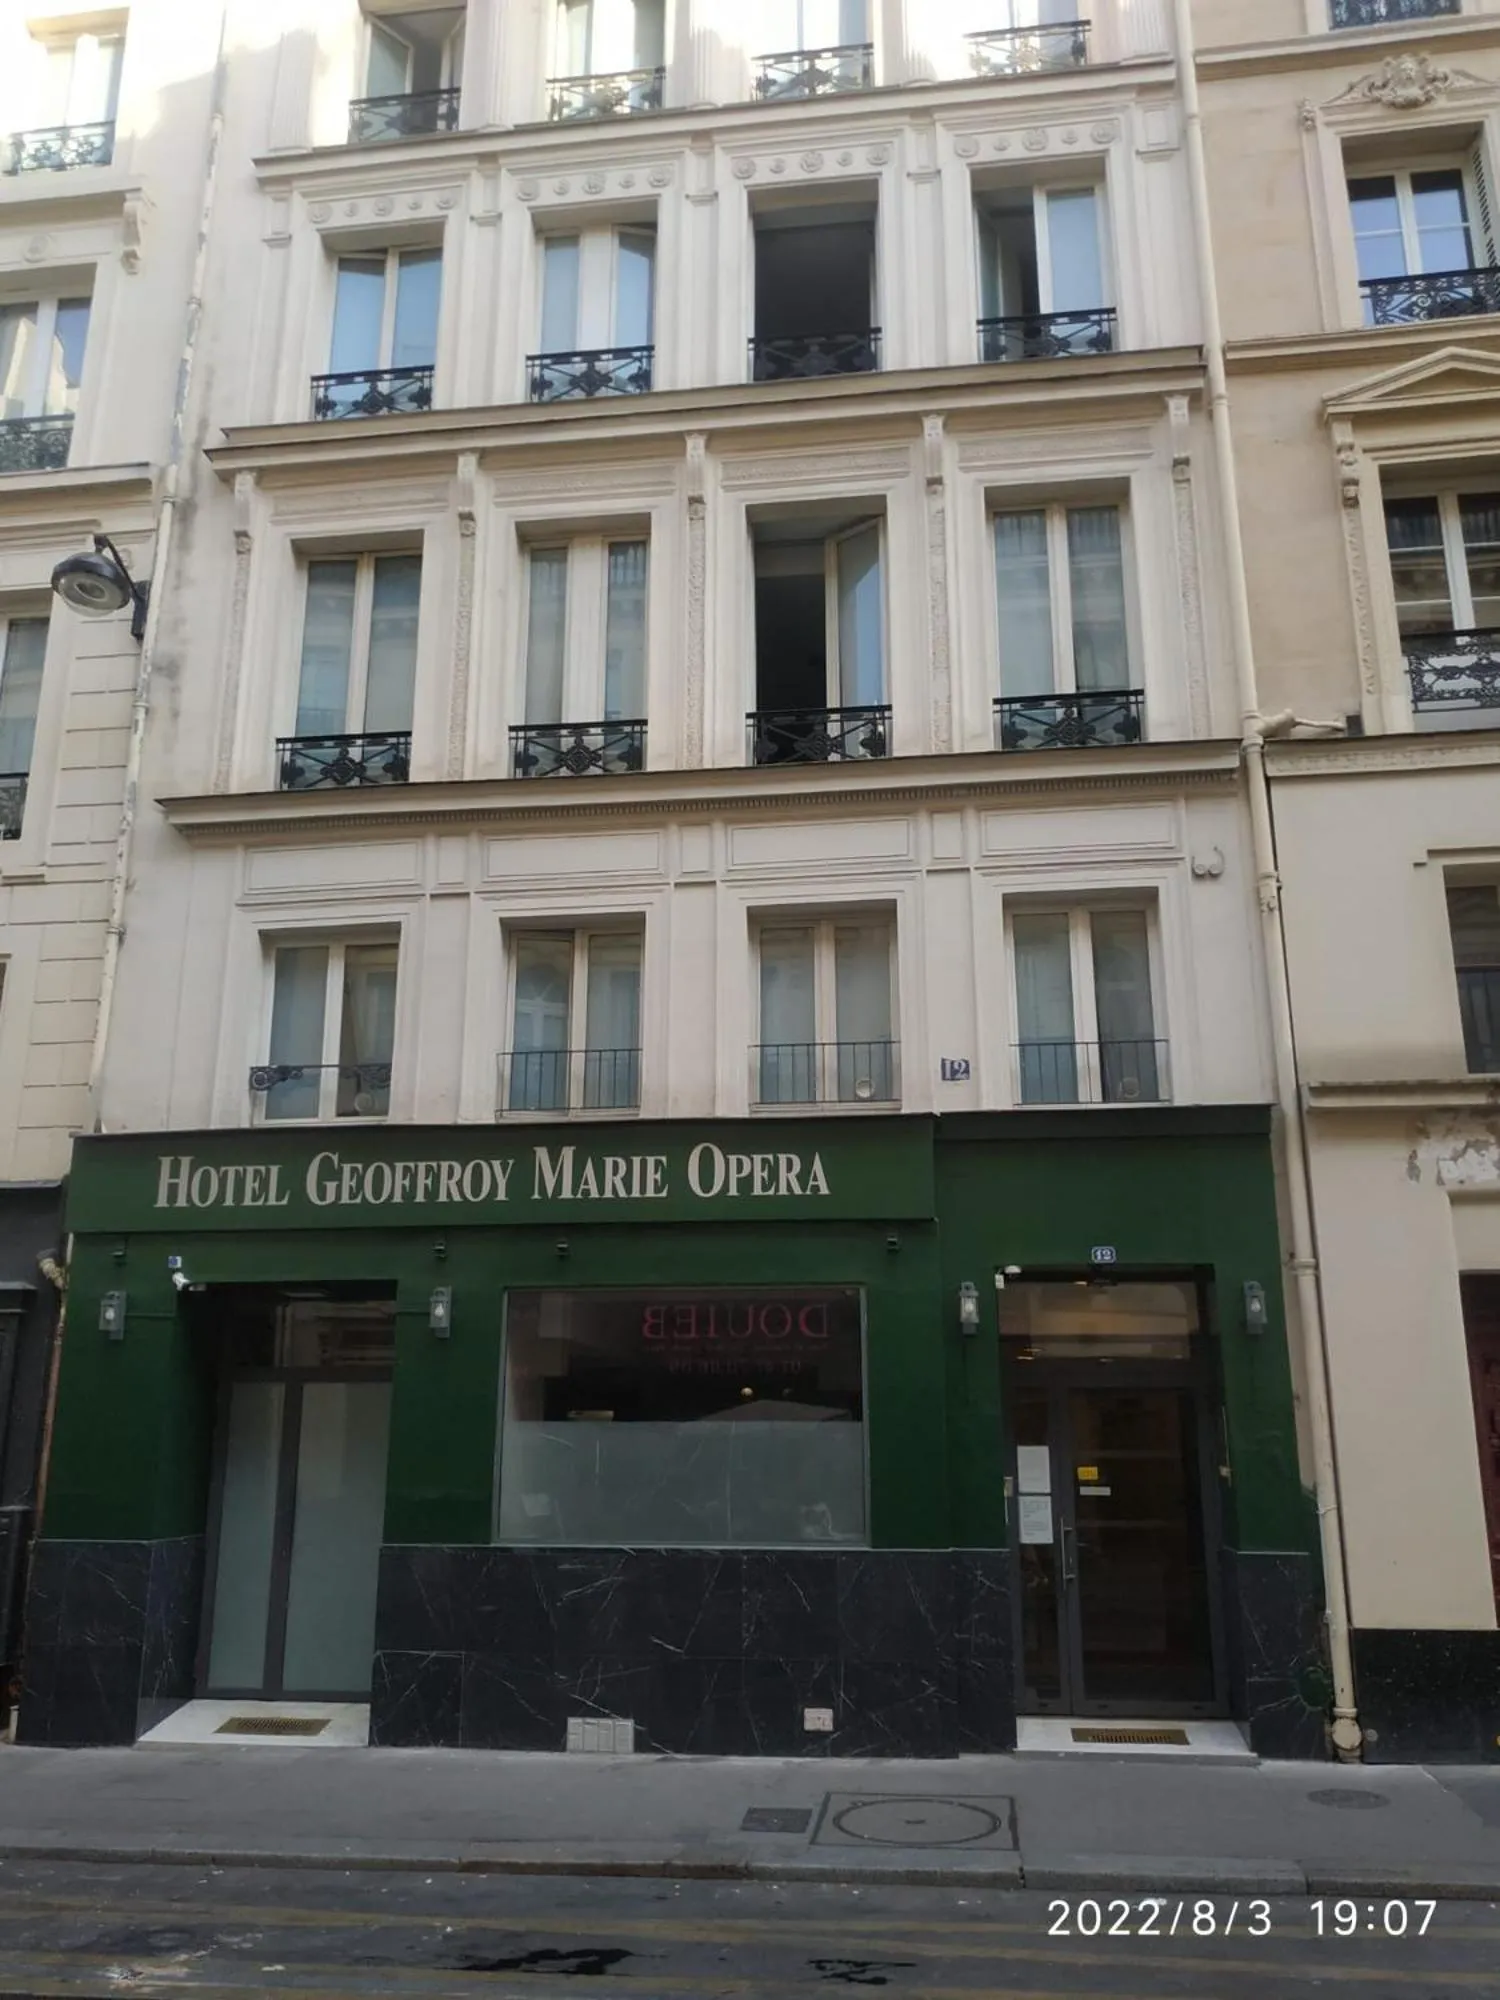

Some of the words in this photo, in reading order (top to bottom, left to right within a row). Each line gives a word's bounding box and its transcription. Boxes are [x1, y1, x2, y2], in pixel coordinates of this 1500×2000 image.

[944, 1060, 968, 1080] 12
[153, 1156, 291, 1208] HOTEL
[305, 1152, 514, 1206] GEOFFROY
[531, 1146, 669, 1199] MARIE
[687, 1142, 831, 1197] OPERA
[1095, 1248, 1112, 1261] 12
